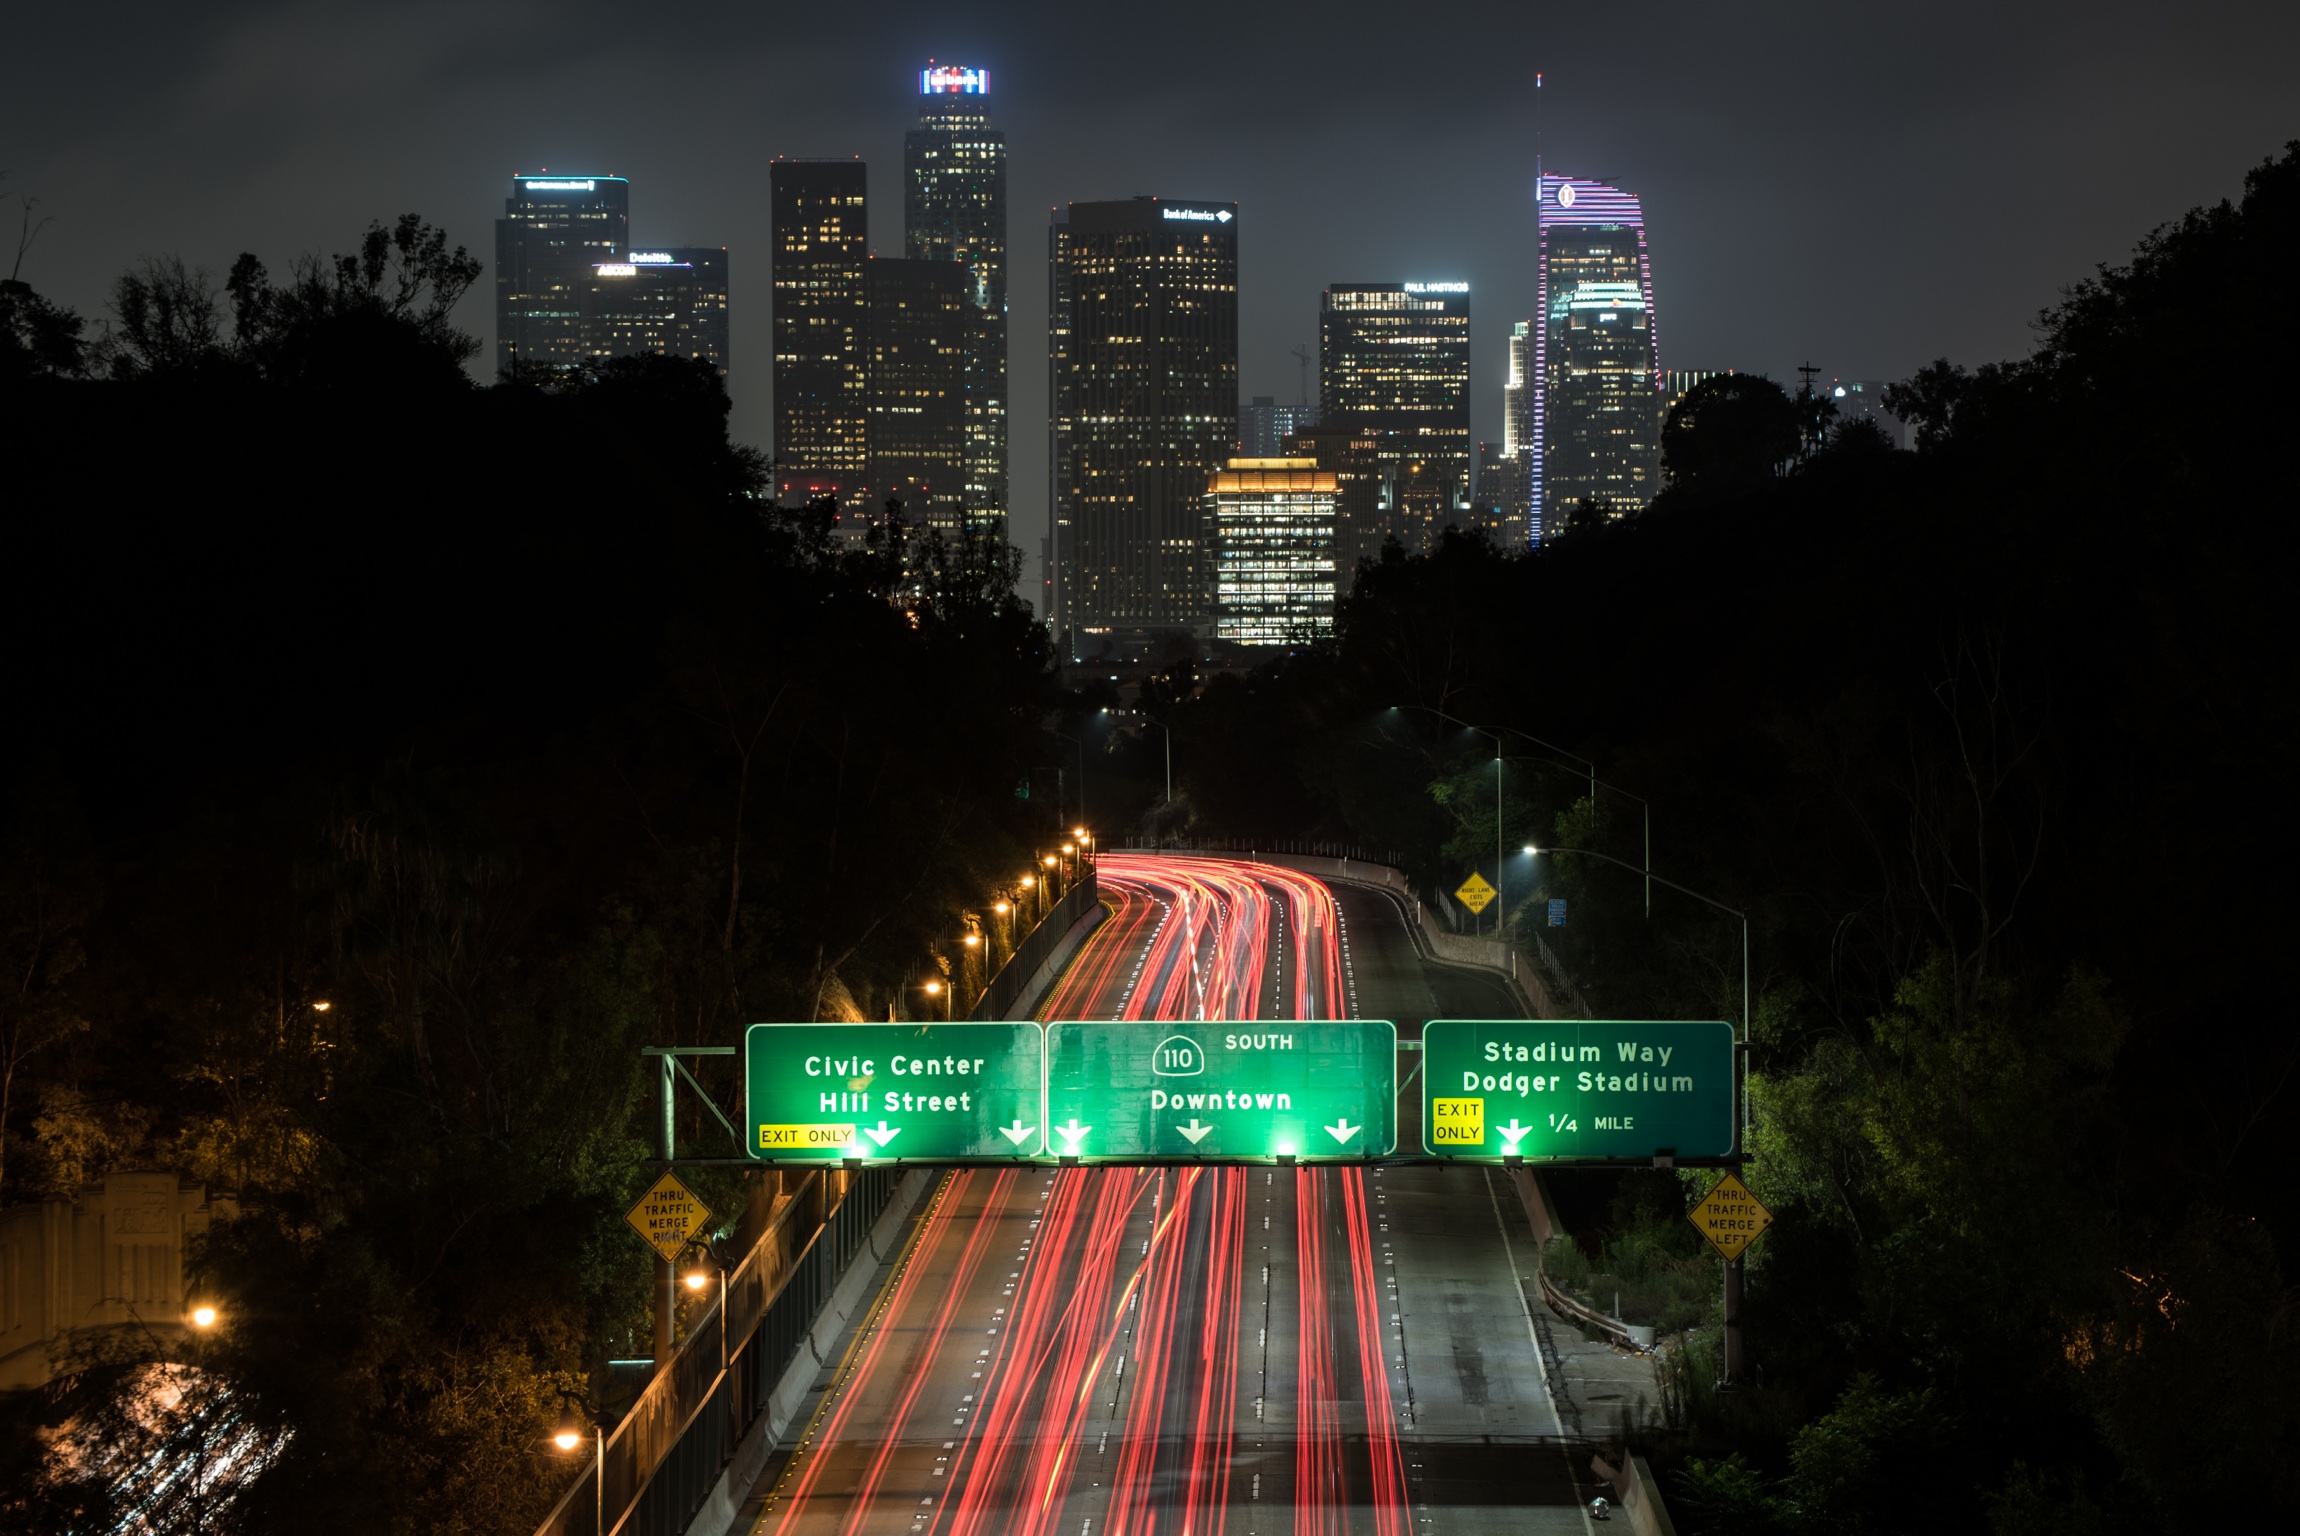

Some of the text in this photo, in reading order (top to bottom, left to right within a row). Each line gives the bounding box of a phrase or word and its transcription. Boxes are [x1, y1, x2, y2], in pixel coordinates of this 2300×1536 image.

[1164, 209, 1215, 221] Bank of America
[1405, 282, 1469, 292] PAUL HASTINGS
[1225, 1034, 1292, 1050] SOUTH
[1164, 1049, 1192, 1068] 110
[1484, 1042, 1672, 1066] Stadium Way
[805, 1056, 984, 1076] Civic Center
[1464, 1072, 1693, 1098] Dodger Stadium
[820, 1092, 970, 1112] Hill Street
[1151, 1090, 1291, 1110] Downtown
[1438, 1104, 1480, 1116] EXIT
[1594, 1117, 1634, 1130] MILE
[762, 1130, 851, 1142] EXIT ONLY
[1436, 1128, 1480, 1138] ONLY
[653, 1190, 684, 1201] THRU
[1716, 1190, 1746, 1200] THRU
[645, 1204, 694, 1216] TRAFFIC
[1707, 1204, 1756, 1216] TRAFFIC
[650, 1218, 688, 1228] MERGE
[1709, 1219, 1754, 1230] MERGE
[1716, 1234, 1748, 1244] LEFT
